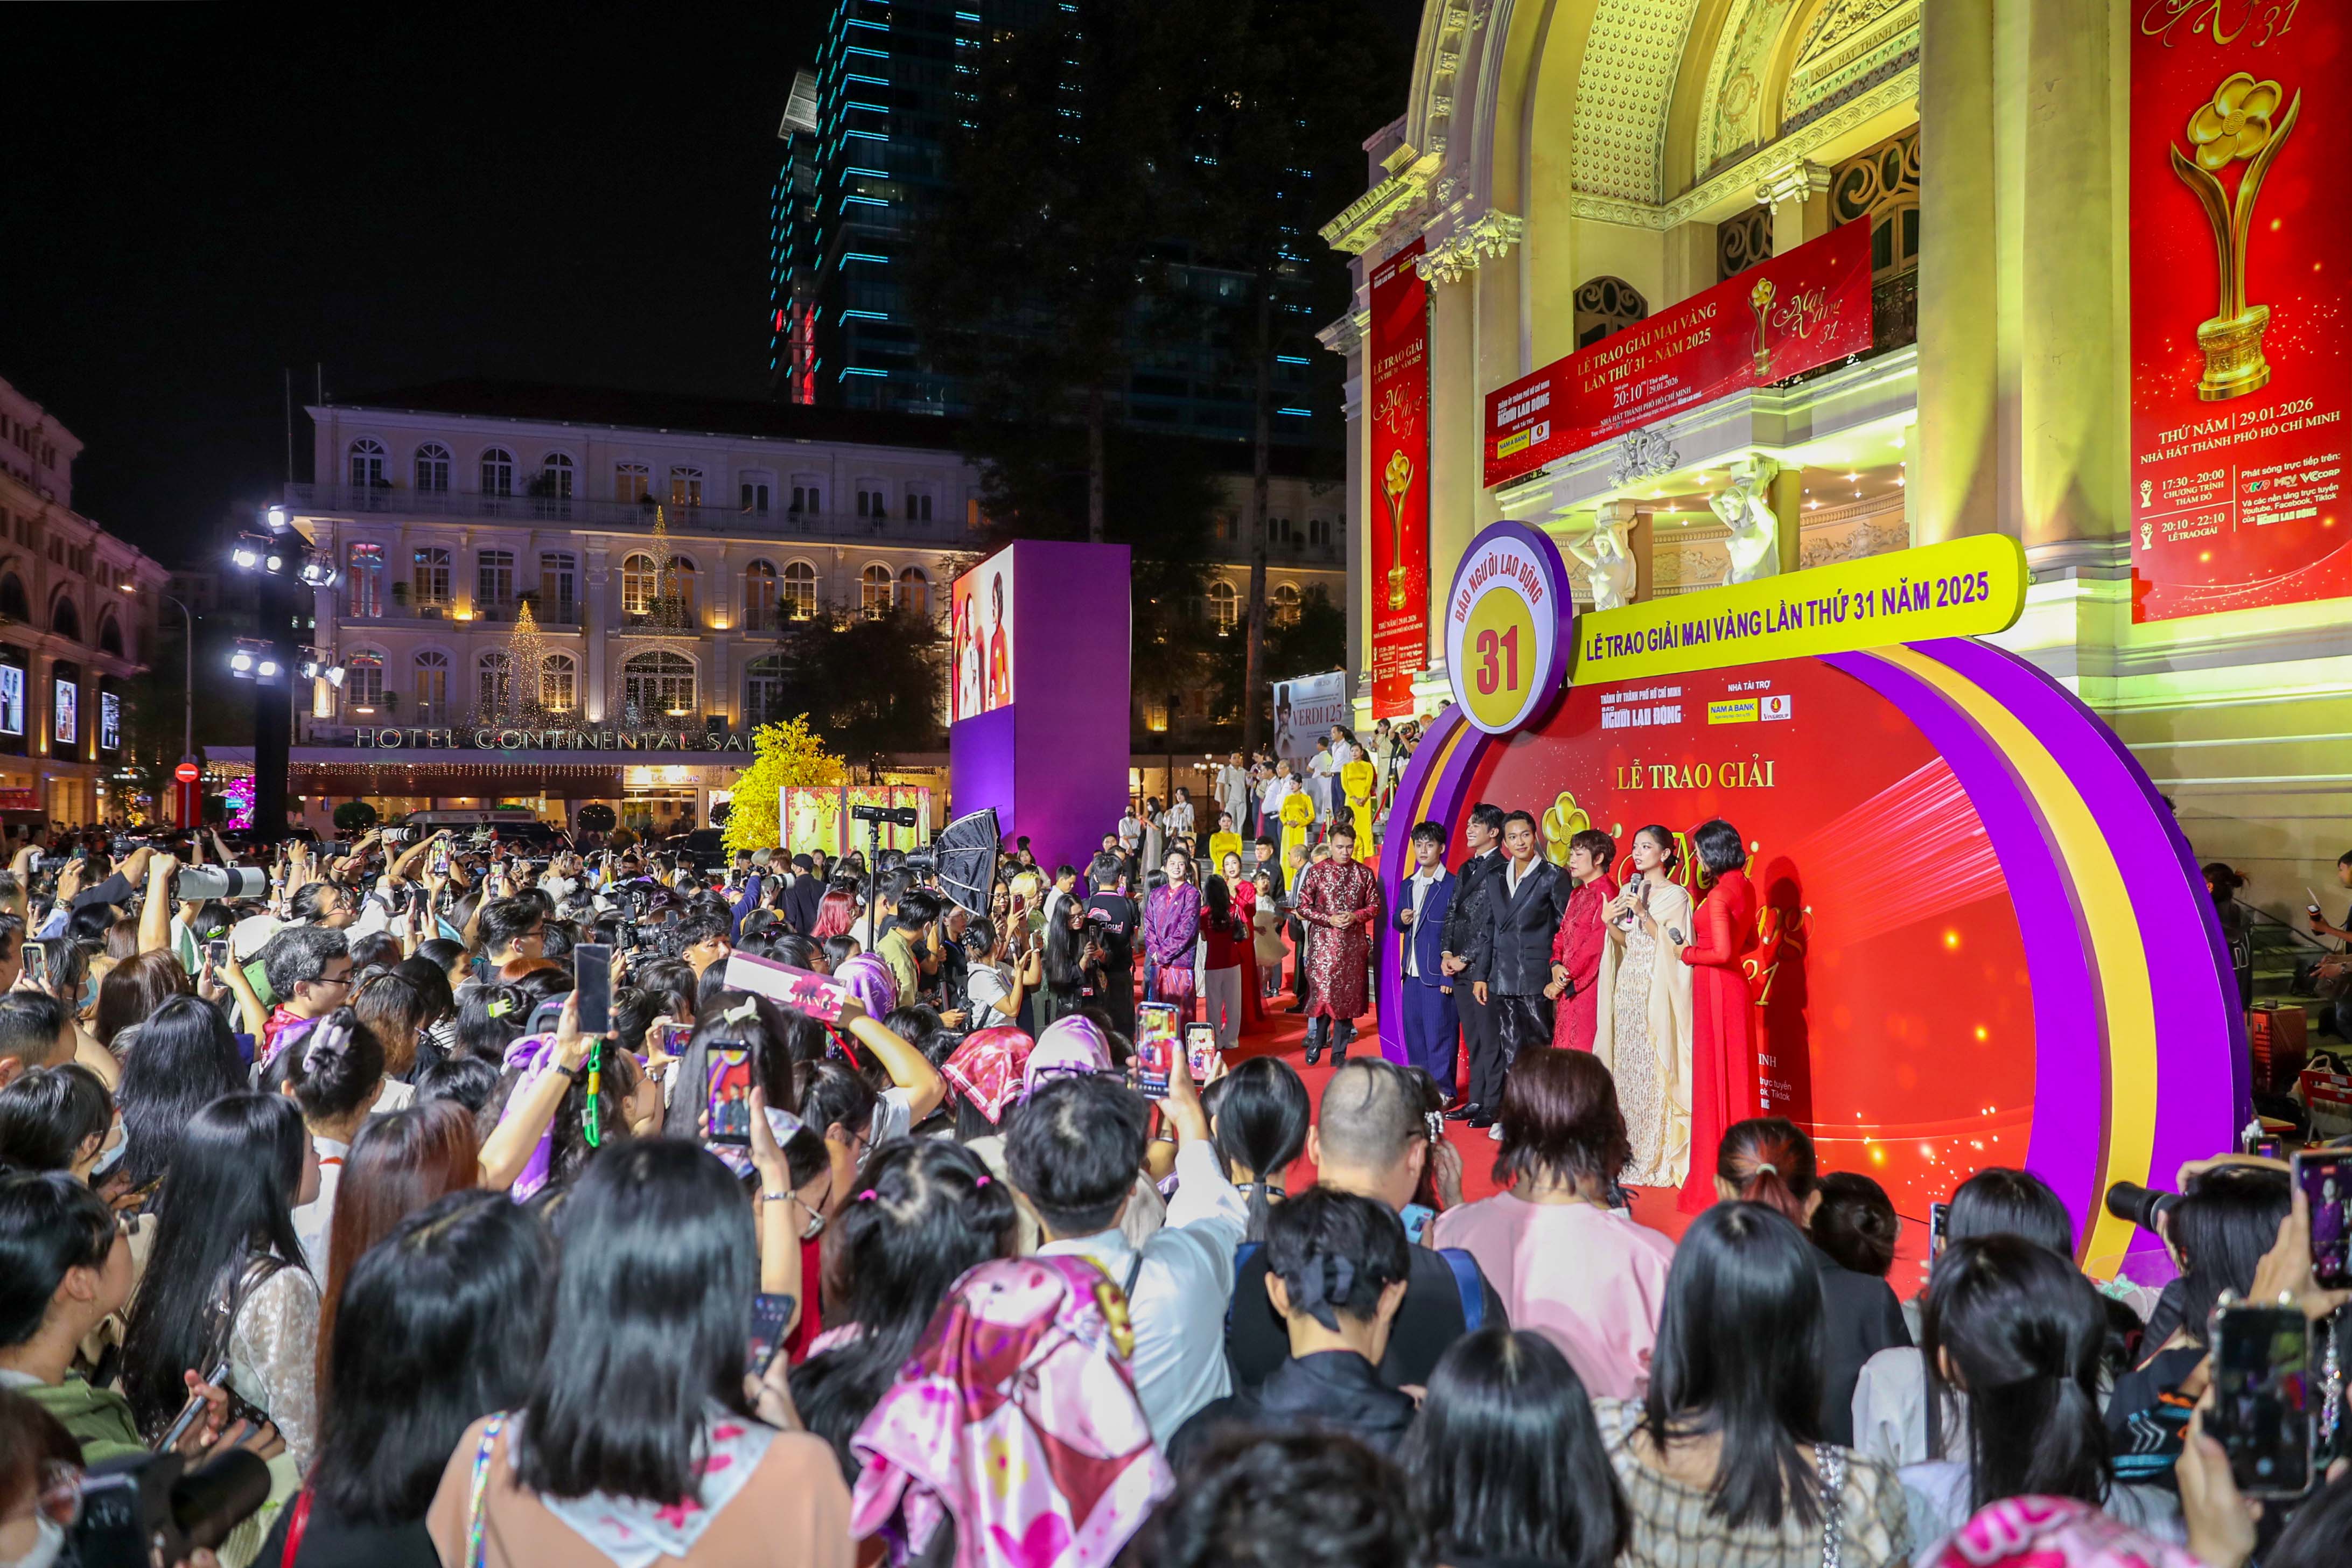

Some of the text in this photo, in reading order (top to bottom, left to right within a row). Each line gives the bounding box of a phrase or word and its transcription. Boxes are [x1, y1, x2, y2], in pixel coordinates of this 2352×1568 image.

[1773, 286, 1825, 328] Mai
[1593, 345, 1623, 369] TRAO
[1626, 331, 1650, 354] GIẢI
[1654, 320, 1677, 342] MAI
[1680, 302, 1717, 329] VÀNG
[1819, 320, 1838, 344] 31
[1384, 350, 1404, 369] TRAO
[1406, 338, 1423, 357] GIẢI
[1608, 358, 1633, 383] THỨ
[1634, 356, 1645, 373] 31
[1655, 339, 1683, 363] NĂM
[1686, 327, 1711, 350] 2025
[1613, 384, 1642, 408] 20:10
[1649, 376, 1678, 395] 29.01.2026
[1676, 386, 1691, 398] MINH
[2159, 397, 2313, 445] THỨ NĂM 29.01.2026
[2140, 410, 2341, 465] NHÀ HÁT THÀNH PHỐ HỒ CHÍ MINH
[2242, 453, 2341, 479] Phát sóng trực tiếp trên:
[2162, 469, 2224, 490] 17:30 20:00
[2164, 481, 2224, 499] CHƯƠNG TRÌNH
[2253, 497, 2266, 505] các
[2268, 494, 2281, 502] nền
[2301, 487, 2316, 496] trực
[2318, 482, 2339, 493] tuyến
[2274, 497, 2312, 509] Facebook,
[2314, 493, 2337, 502] Tiktok
[2161, 513, 2225, 533] 20:10 22:10
[2179, 530, 2200, 540] TRAO
[1455, 552, 1543, 624] BÁO NGƯỜI LAO ĐỘNG
[1586, 571, 1990, 661] LỄ TRAO GIẢI MAI VÀNG LẦN THỨ 31 NĂM 2025
[1476, 625, 1518, 695] 31
[1600, 686, 1681, 704] THÀNH ỦY THÀNH PHỐ HỒ CHÍ MINH
[1728, 680, 1770, 692] NHÀ TÀI TRỢ
[1293, 704, 1341, 726] VERDI 125
[1602, 705, 1681, 729] NGƯỜI LAO ĐỘNG
[1734, 703, 1754, 711] BANK
[353, 728, 459, 748] HOTEL
[474, 730, 692, 750] CONTINENTAL
[1617, 753, 1775, 789] LỄ TRAO GIẢI
[1758, 1053, 1776, 1067] INH
[1771, 1089, 1790, 1101] Tiktok
